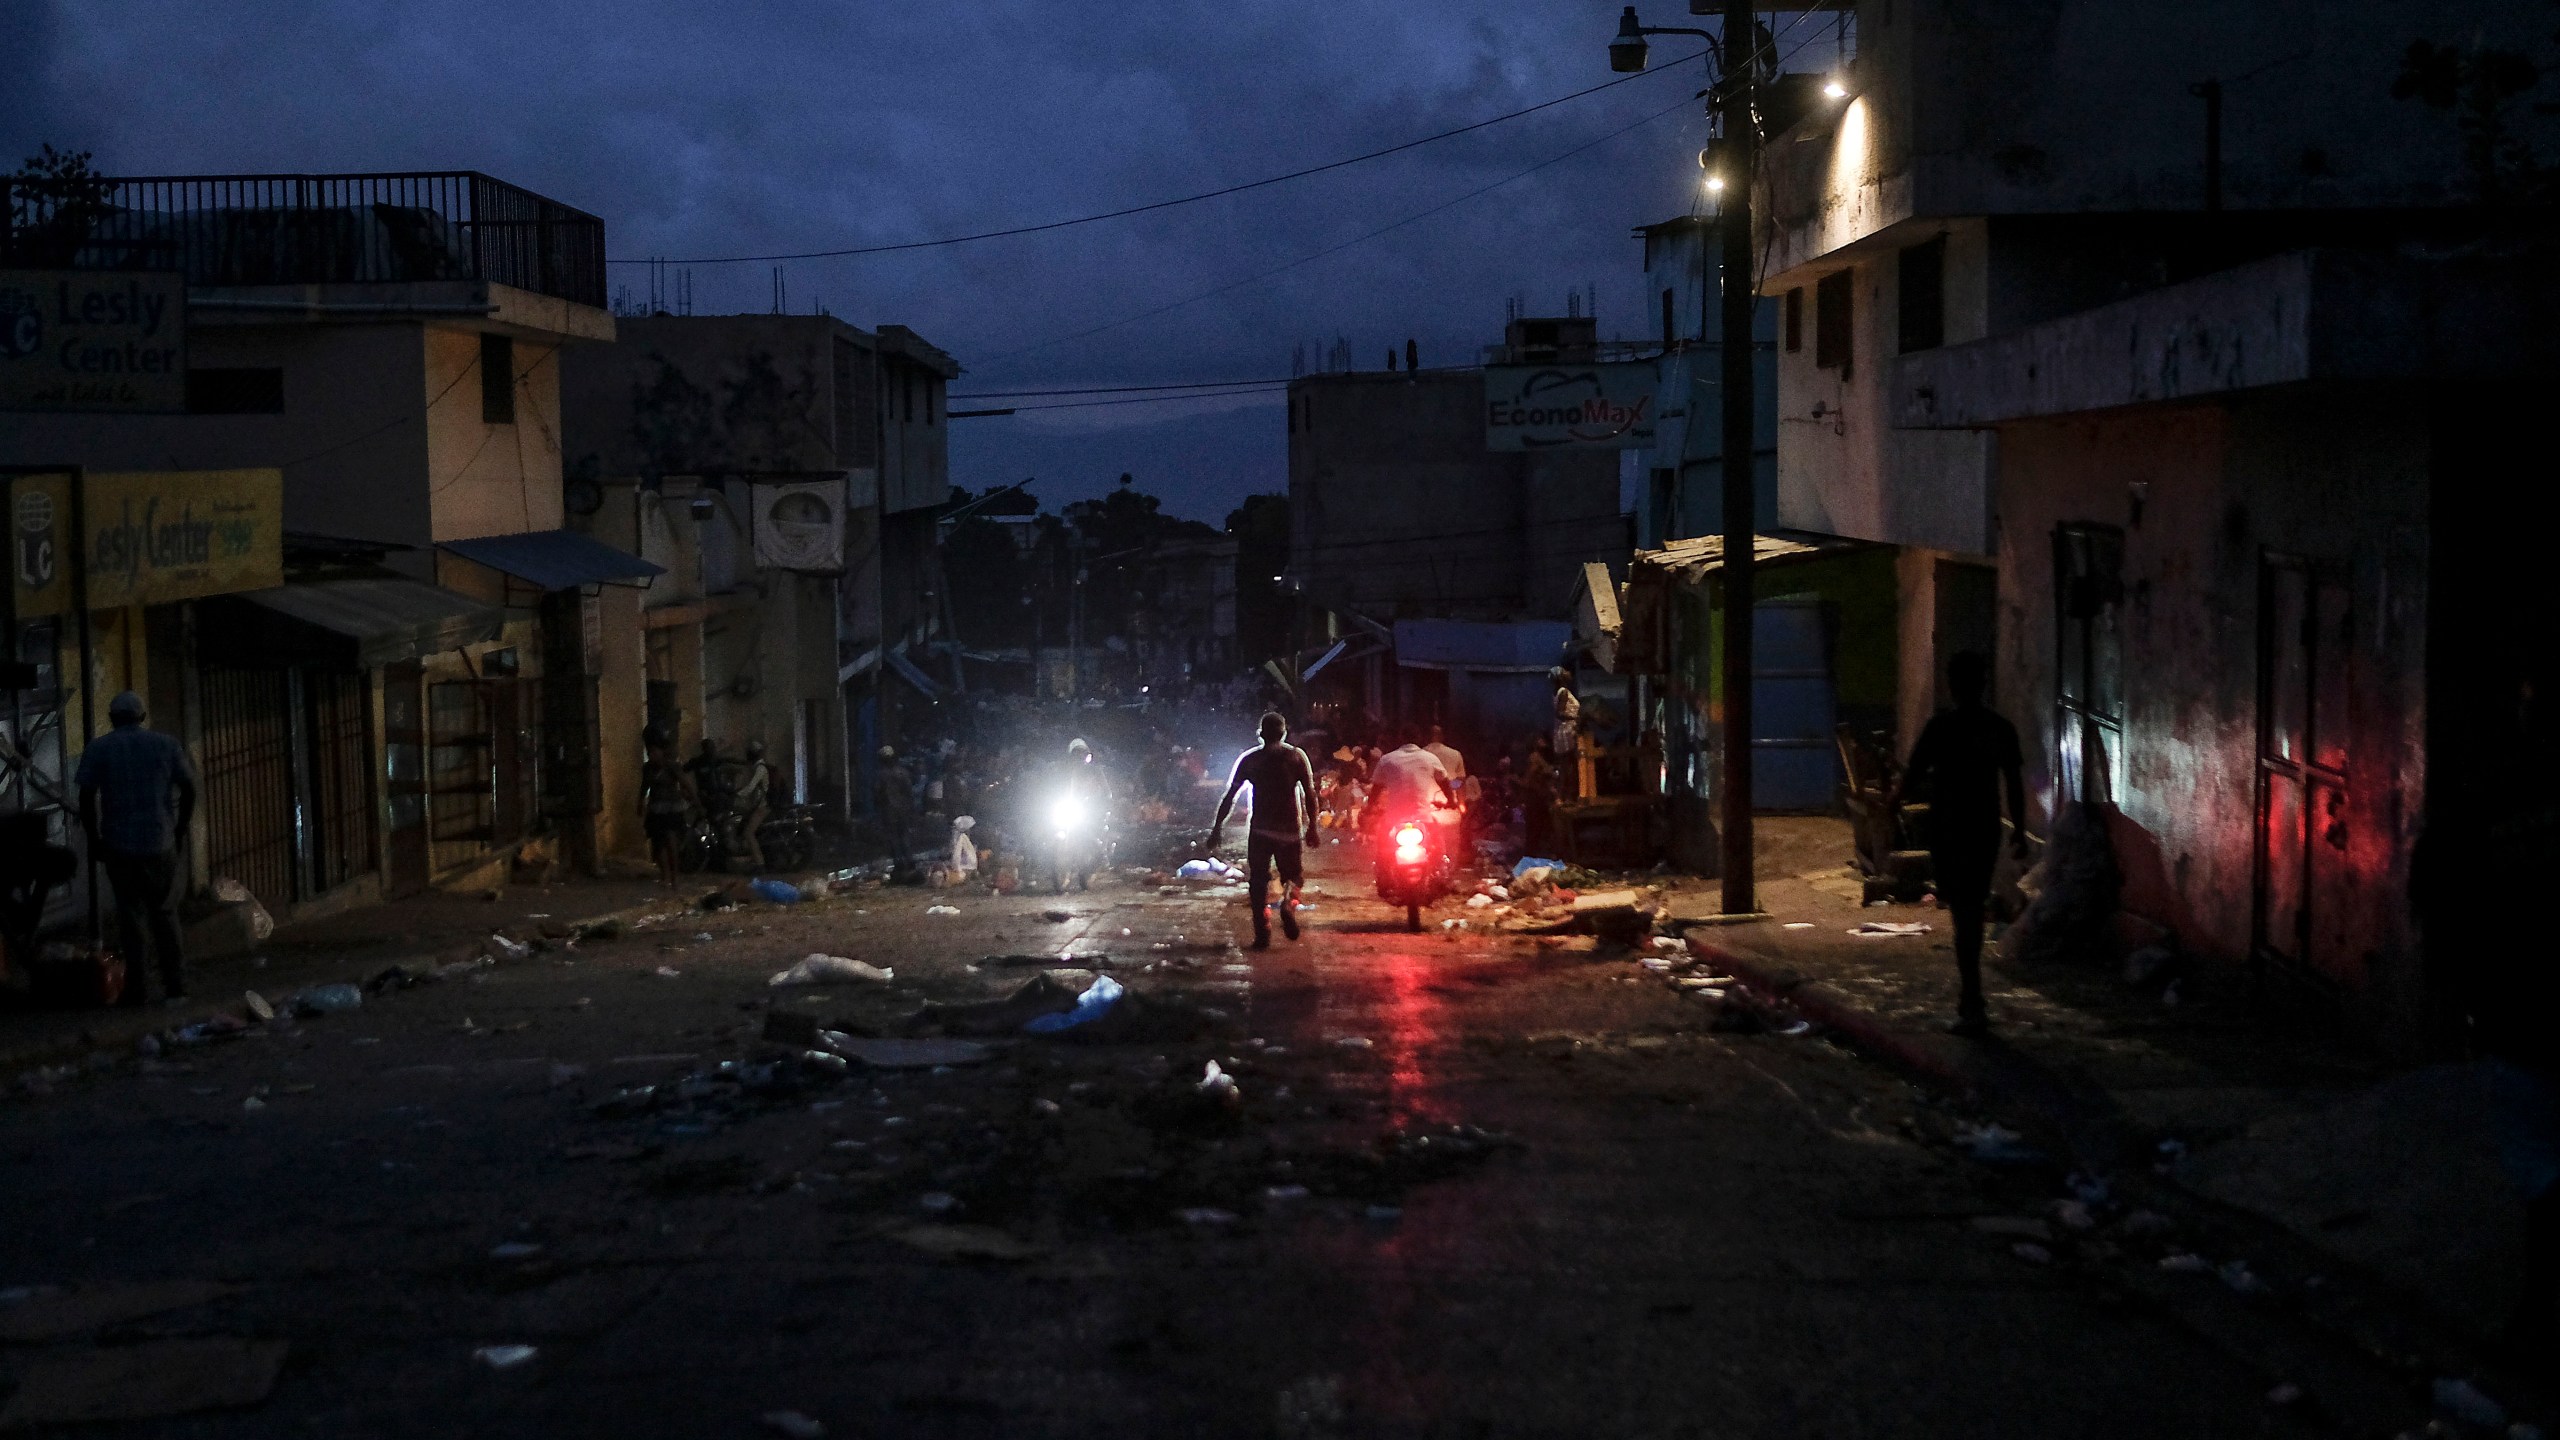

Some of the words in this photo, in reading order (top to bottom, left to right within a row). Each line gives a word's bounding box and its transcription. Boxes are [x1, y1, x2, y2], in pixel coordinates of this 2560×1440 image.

[59, 280, 165, 336] Lesly
[60, 337, 176, 373] Center
[1489, 395, 1649, 427] EconoMax
[146, 496, 213, 567] Center
[19, 538, 53, 585] LC
